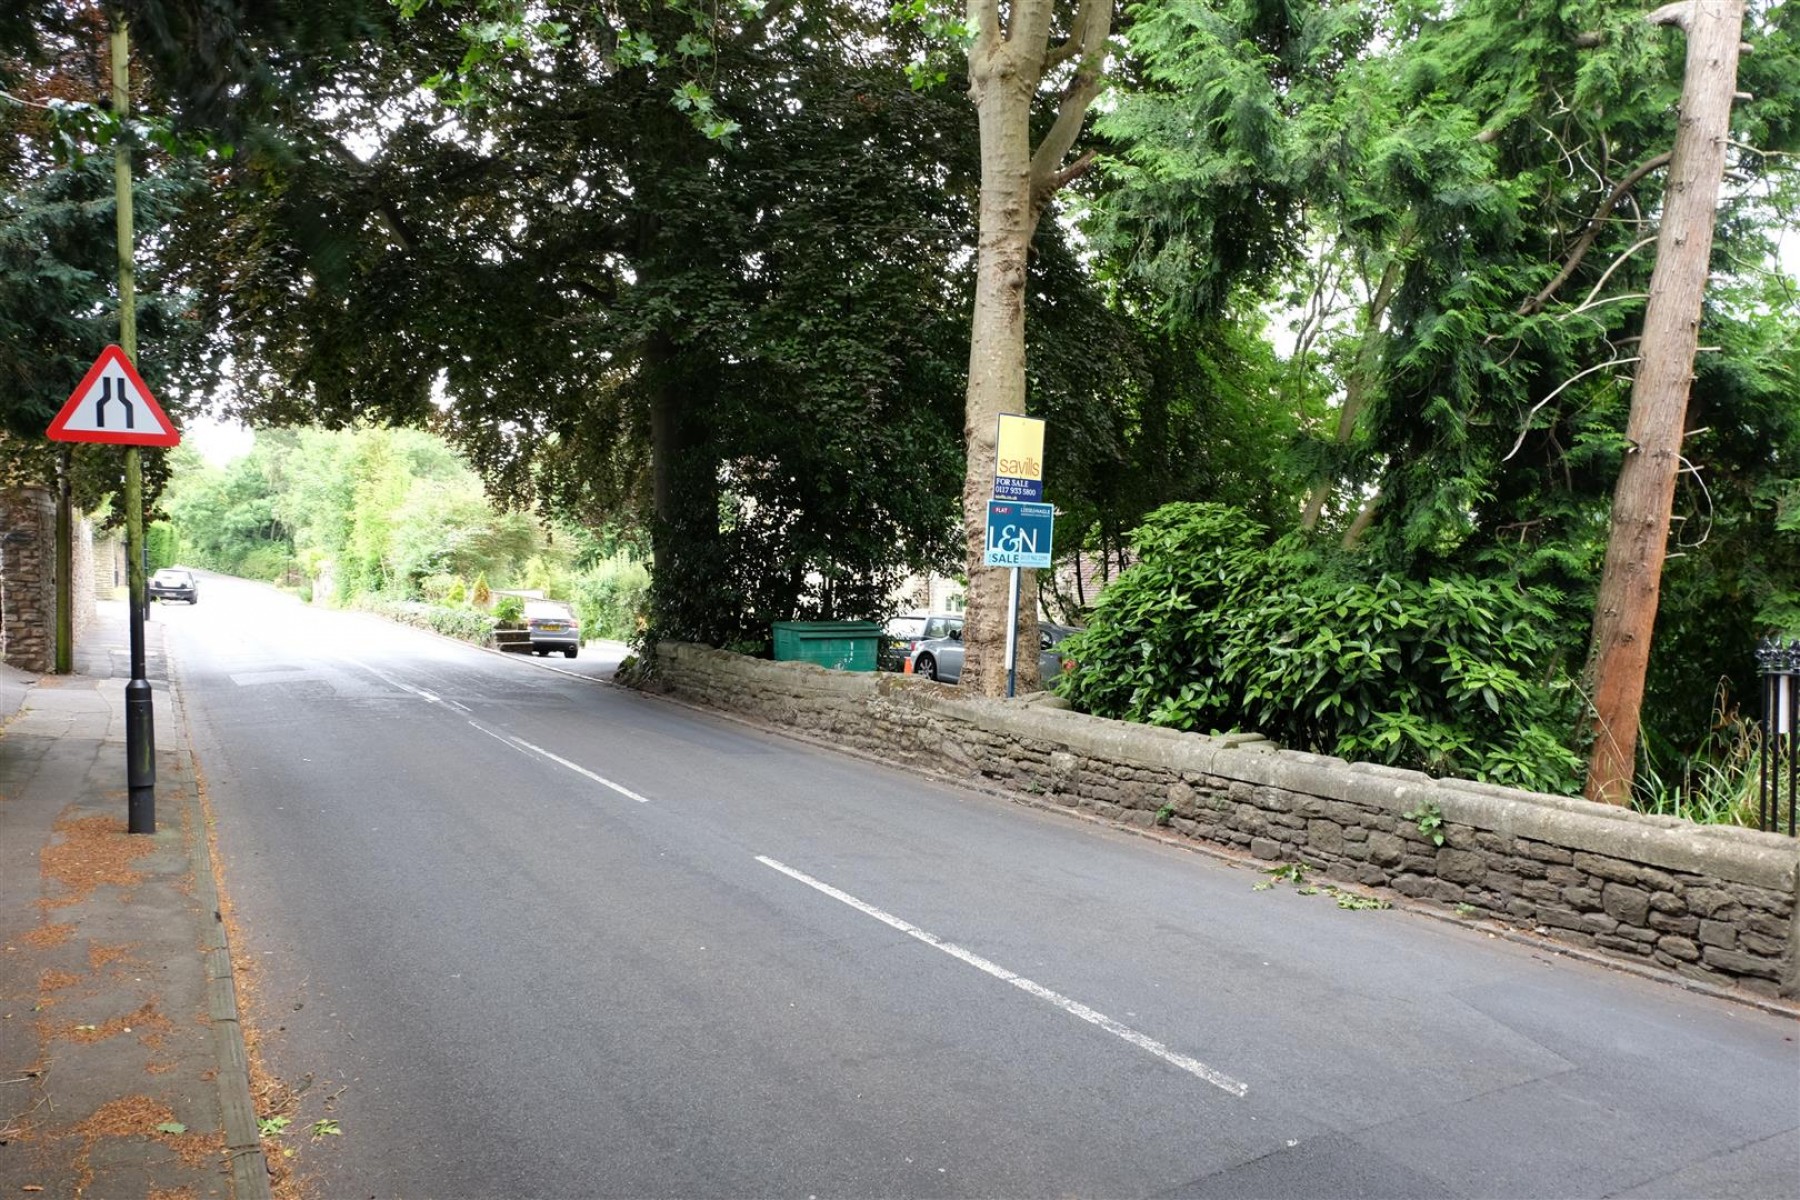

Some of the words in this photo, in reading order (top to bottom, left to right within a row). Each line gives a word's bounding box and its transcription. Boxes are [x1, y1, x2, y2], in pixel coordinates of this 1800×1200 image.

[999, 458, 1040, 477] savills
[996, 478, 1010, 486] FOR
[1011, 479, 1028, 487] SALE
[989, 524, 1037, 553] L&N
[992, 553, 1018, 563] SALE
